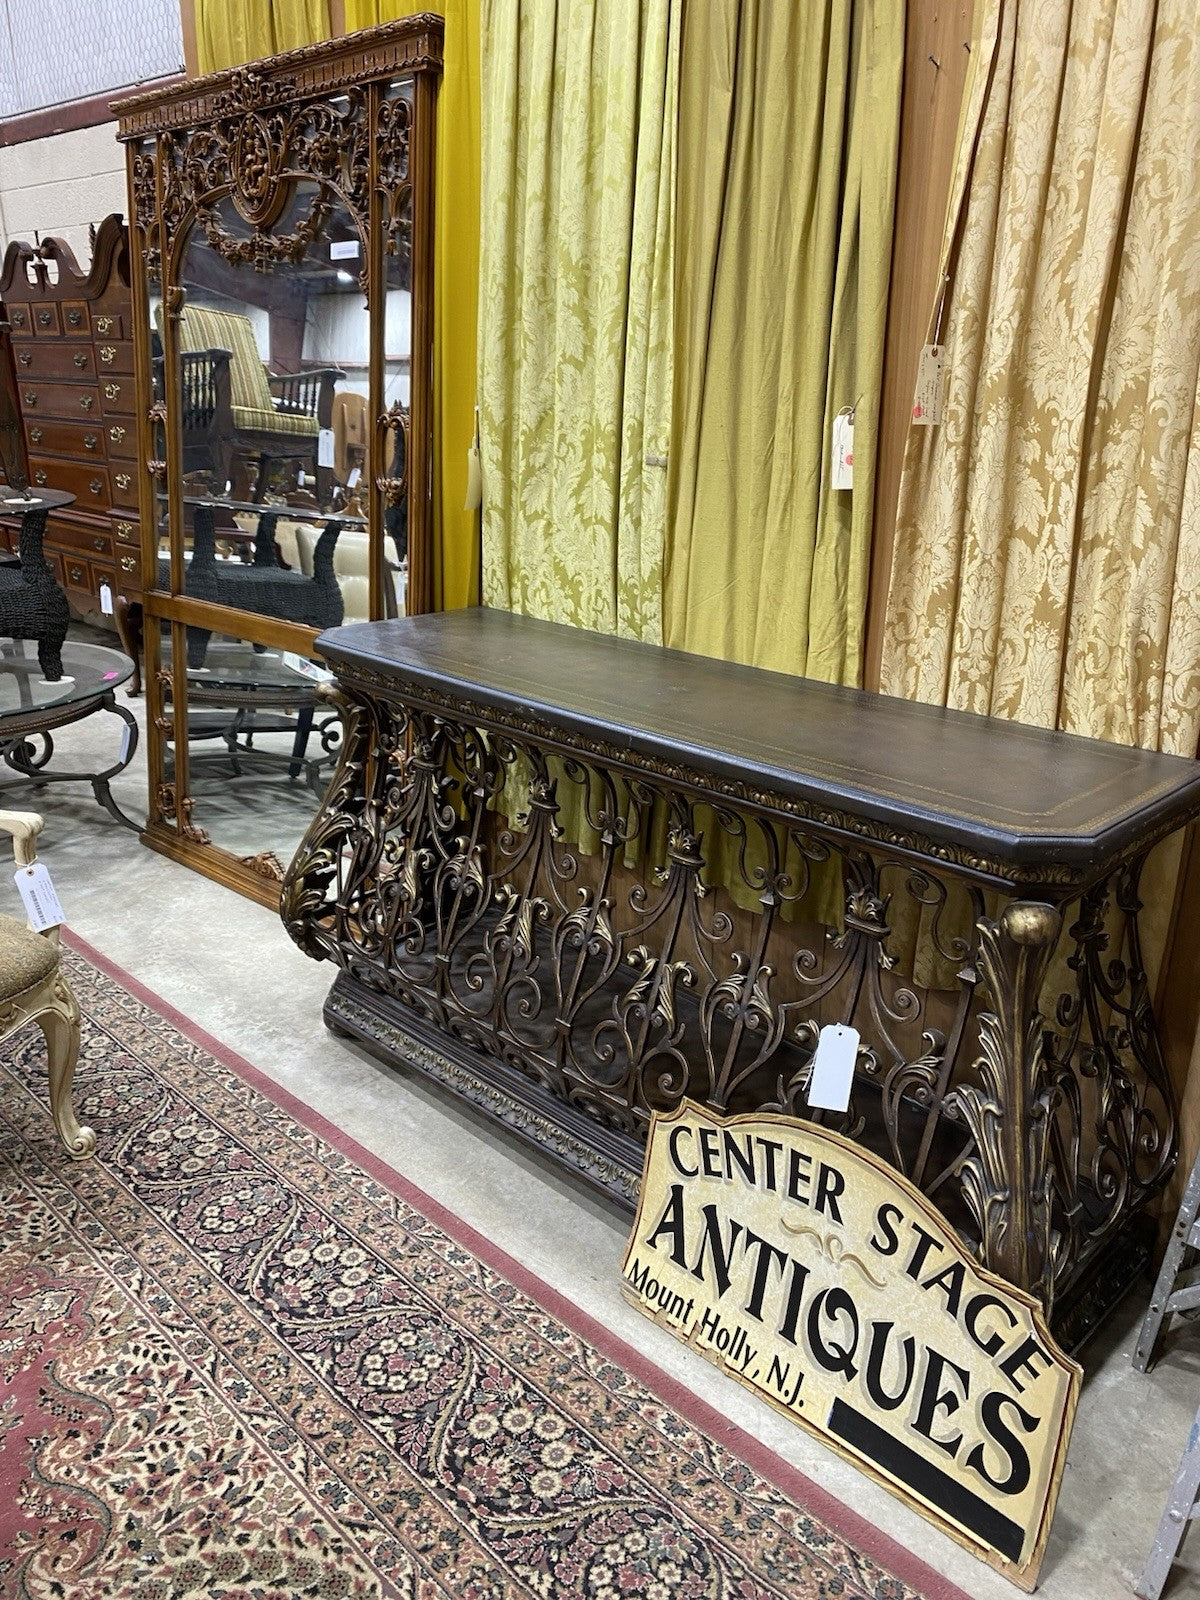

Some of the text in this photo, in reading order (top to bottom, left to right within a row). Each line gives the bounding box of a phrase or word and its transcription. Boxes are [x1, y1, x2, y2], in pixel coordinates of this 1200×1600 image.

[627, 1258, 805, 1408] Mount Holly, N.J.
[646, 1185, 1041, 1496] ANTIQUES
[669, 1126, 1053, 1393] CENTER STAGE
